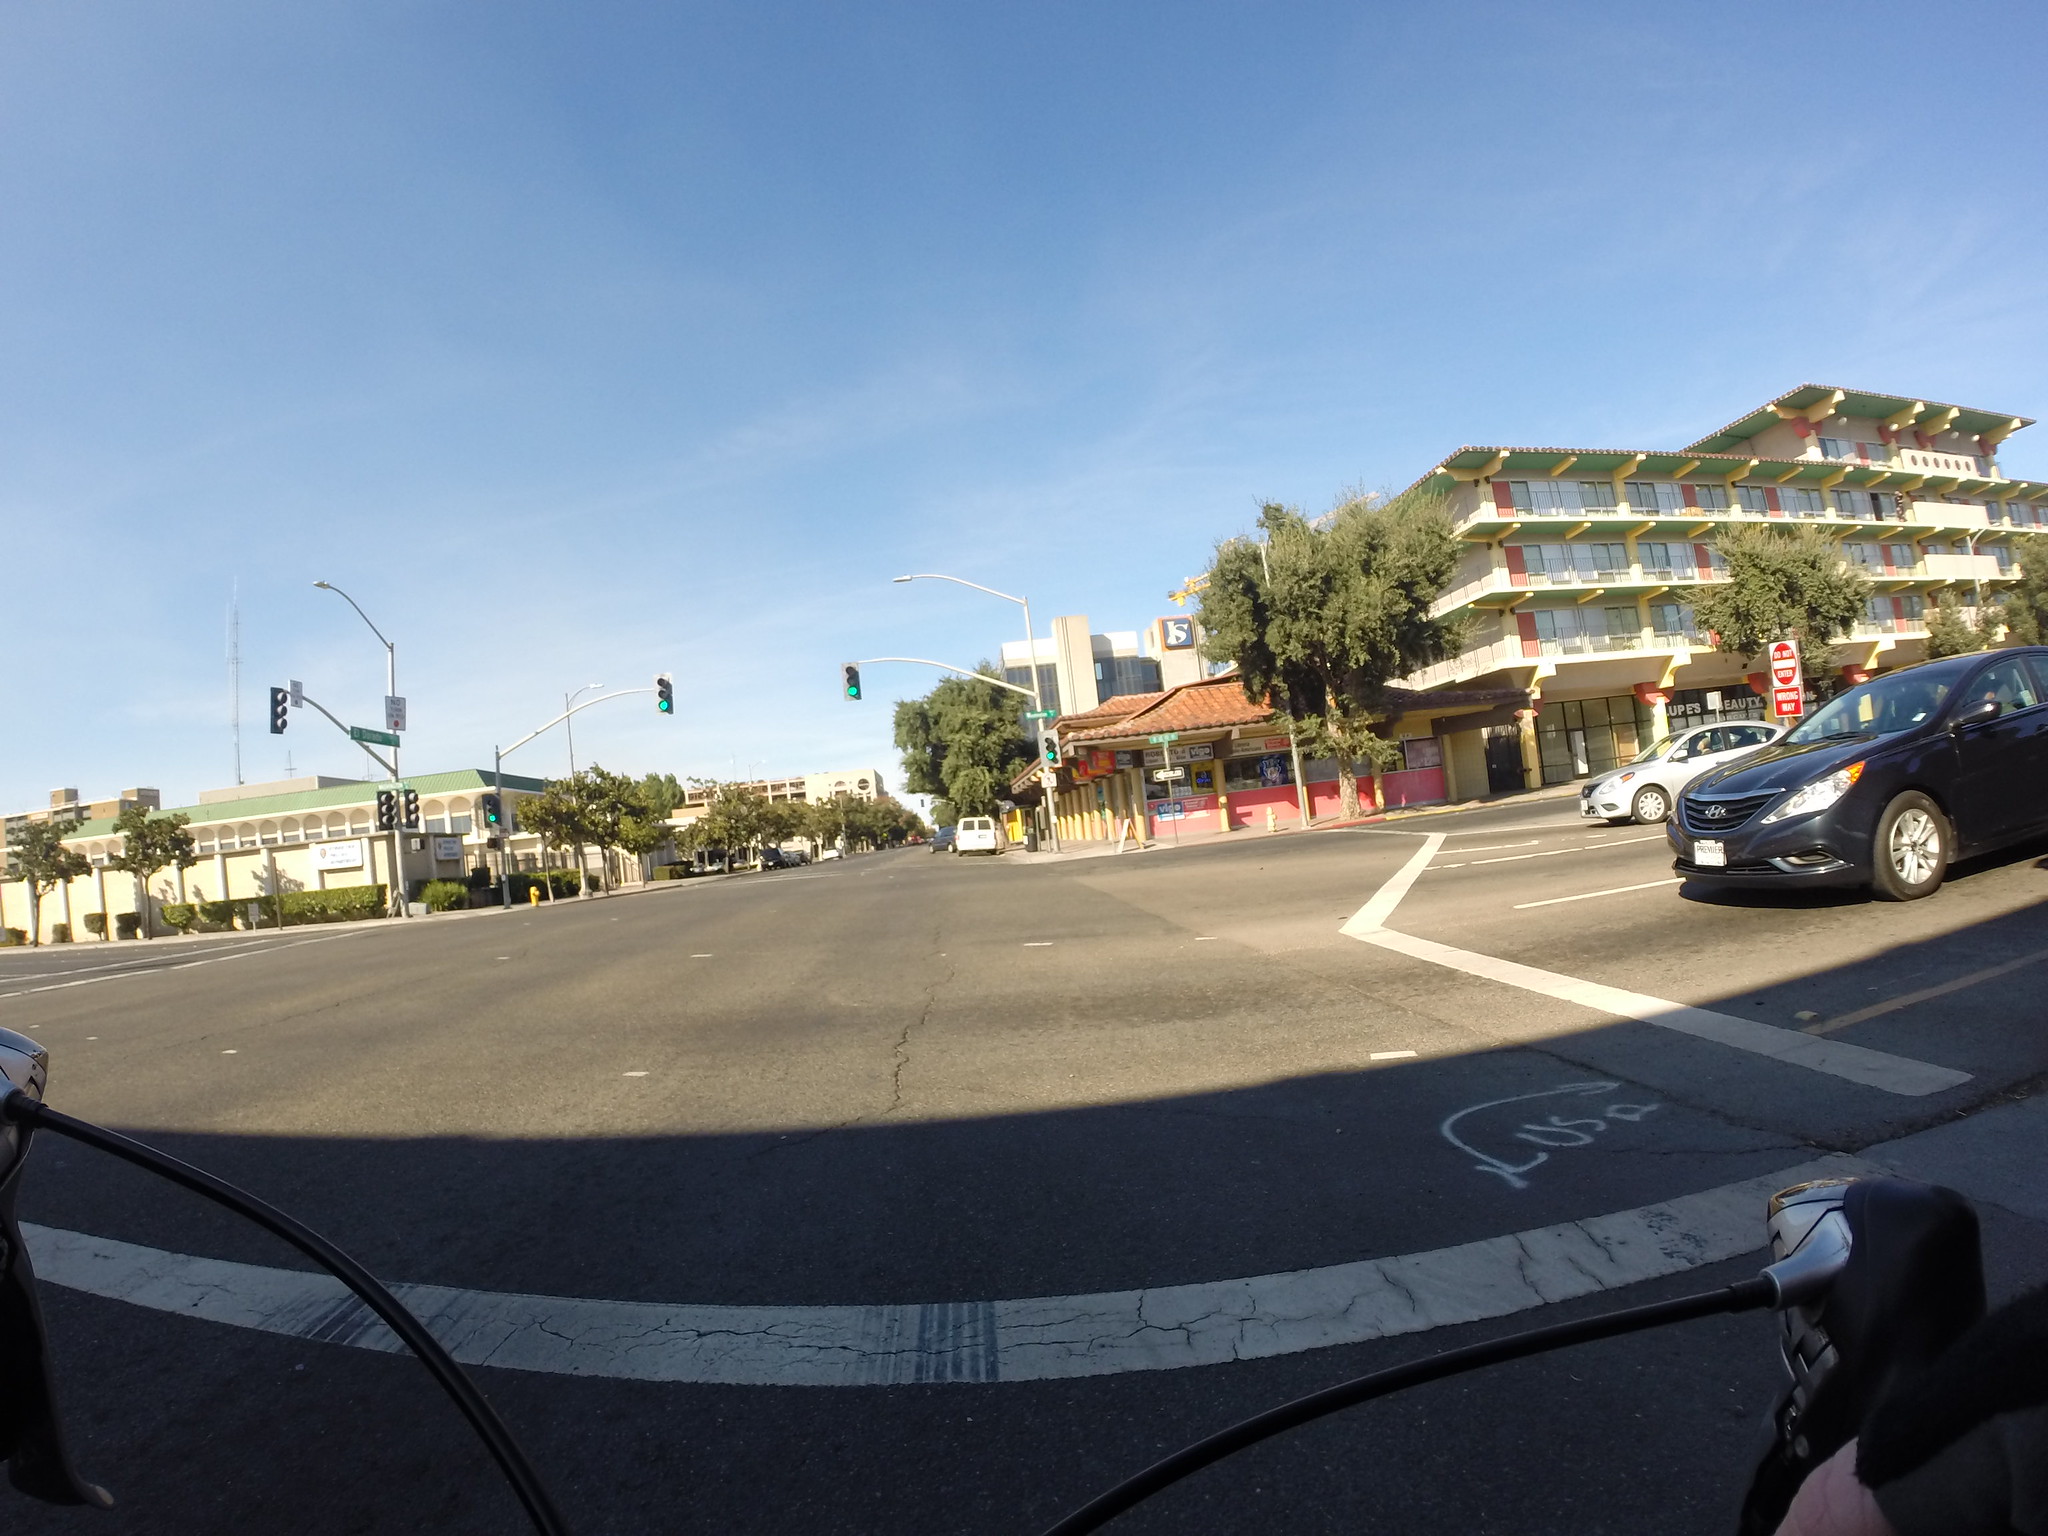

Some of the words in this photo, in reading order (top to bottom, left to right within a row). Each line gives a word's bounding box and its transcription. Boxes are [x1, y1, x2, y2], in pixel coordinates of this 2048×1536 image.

[1774, 651, 1781, 659] DO
[1777, 670, 1793, 678] ENTER
[1776, 691, 1798, 701] WRONG
[1668, 703, 1701, 716] UPE'S
[1781, 703, 1795, 711] WAY
[1145, 750, 1179, 758] ROBETO
